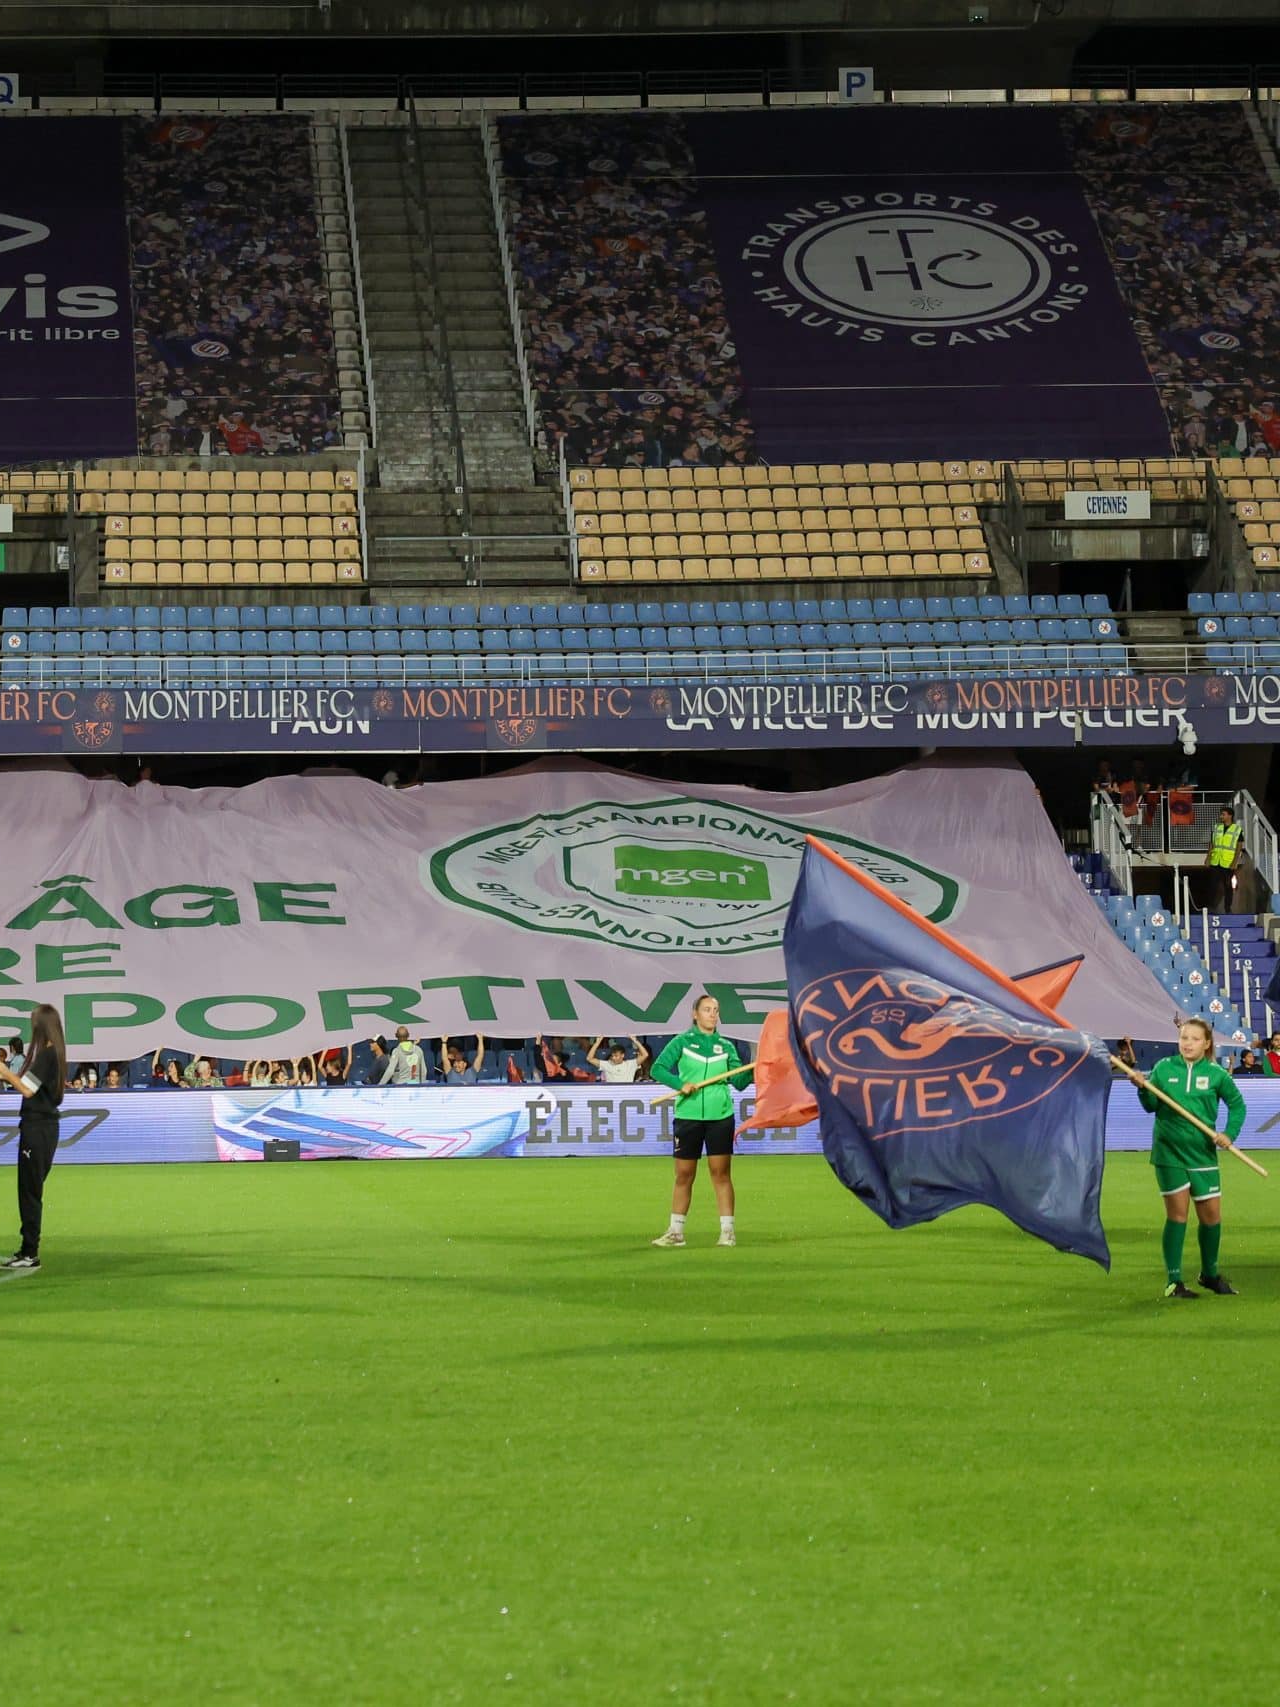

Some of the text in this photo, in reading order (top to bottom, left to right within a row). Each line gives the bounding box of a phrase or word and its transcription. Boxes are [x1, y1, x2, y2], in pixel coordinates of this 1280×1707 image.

[845, 72, 867, 97] P
[741, 192, 1078, 262] TRANSPORTS DES
[753, 281, 1089, 348] HAUTS CANTONS
[45, 325, 121, 343] libre
[1086, 496, 1128, 514] CEVENNES
[37, 691, 76, 721] FC
[124, 689, 309, 720] MONTPELLIER
[317, 689, 355, 718] FC
[402, 688, 586, 718] MONTPELLIER
[594, 688, 632, 717] FC
[679, 685, 863, 716] MONTPELLIER
[870, 685, 909, 714] FC
[956, 677, 1140, 711] MONTPELLIER
[1148, 677, 1186, 706] FC
[556, 811, 838, 855] CHAMPIONNE
[616, 868, 746, 886] mgen
[5, 874, 346, 930] ÂGE
[538, 903, 785, 947] AMPIONNES
